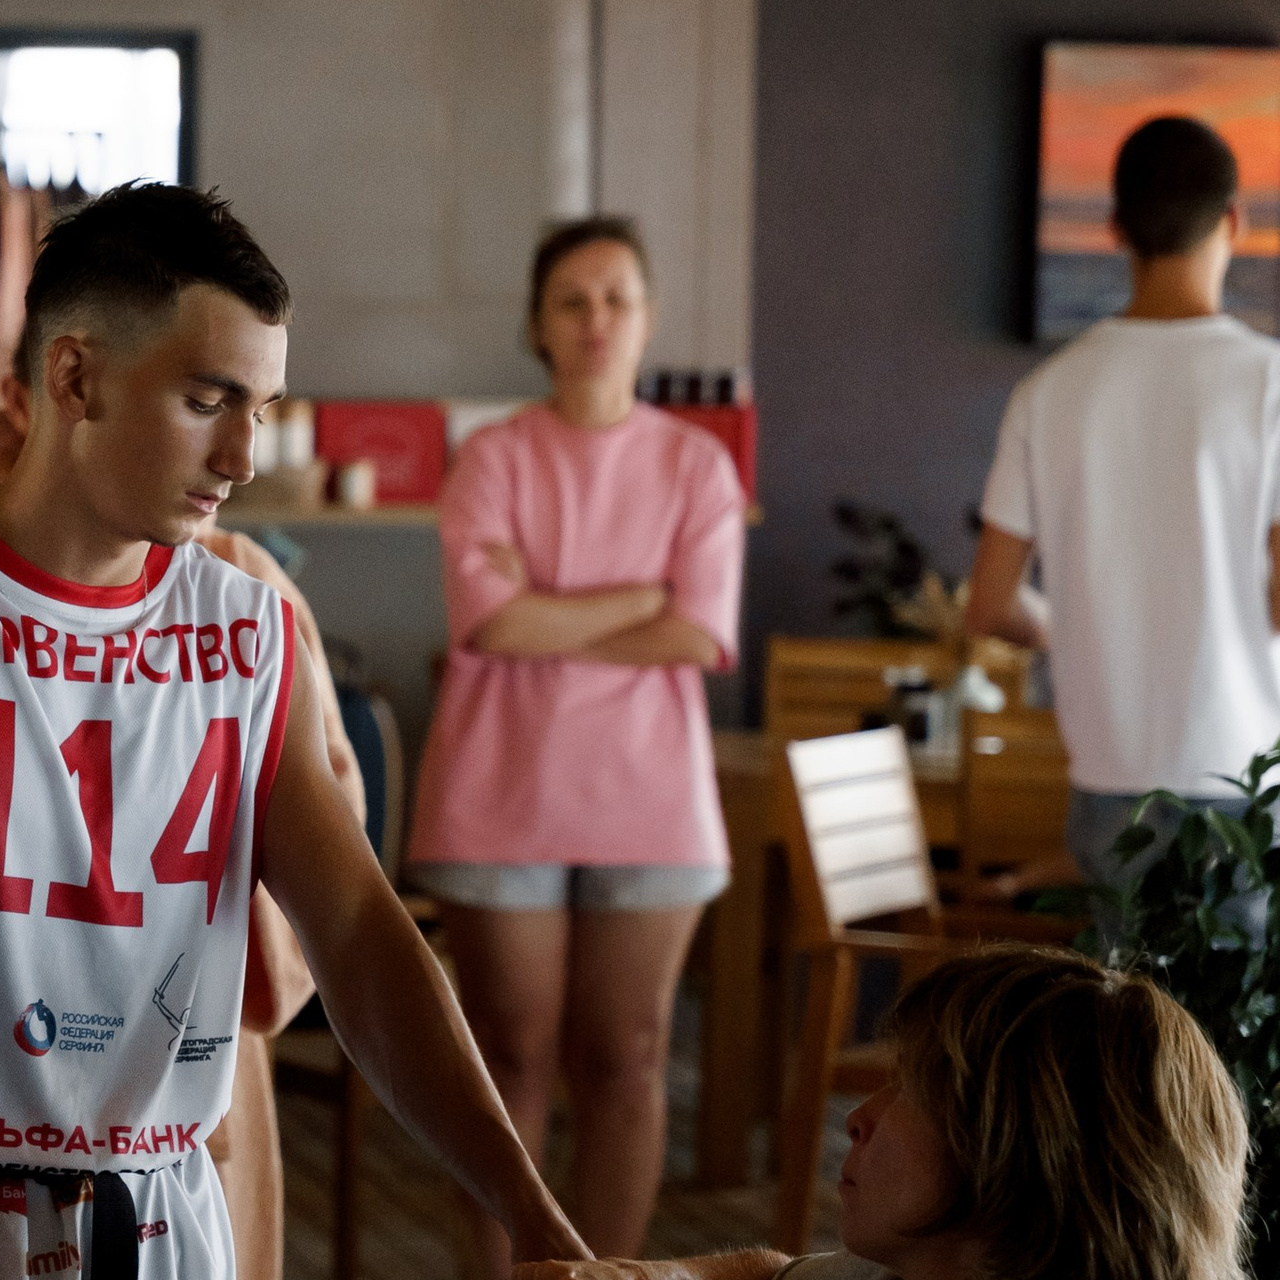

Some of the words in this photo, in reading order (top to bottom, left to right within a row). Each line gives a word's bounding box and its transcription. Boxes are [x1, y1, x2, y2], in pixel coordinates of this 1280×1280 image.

[61, 1012, 124, 1028] РОССИЙСКАЯ
[59, 1027, 115, 1041] ФЕДЕРАЦИЯ
[58, 1040, 105, 1053] СЕРФИНГА
[27, 1240, 82, 1276] mily
